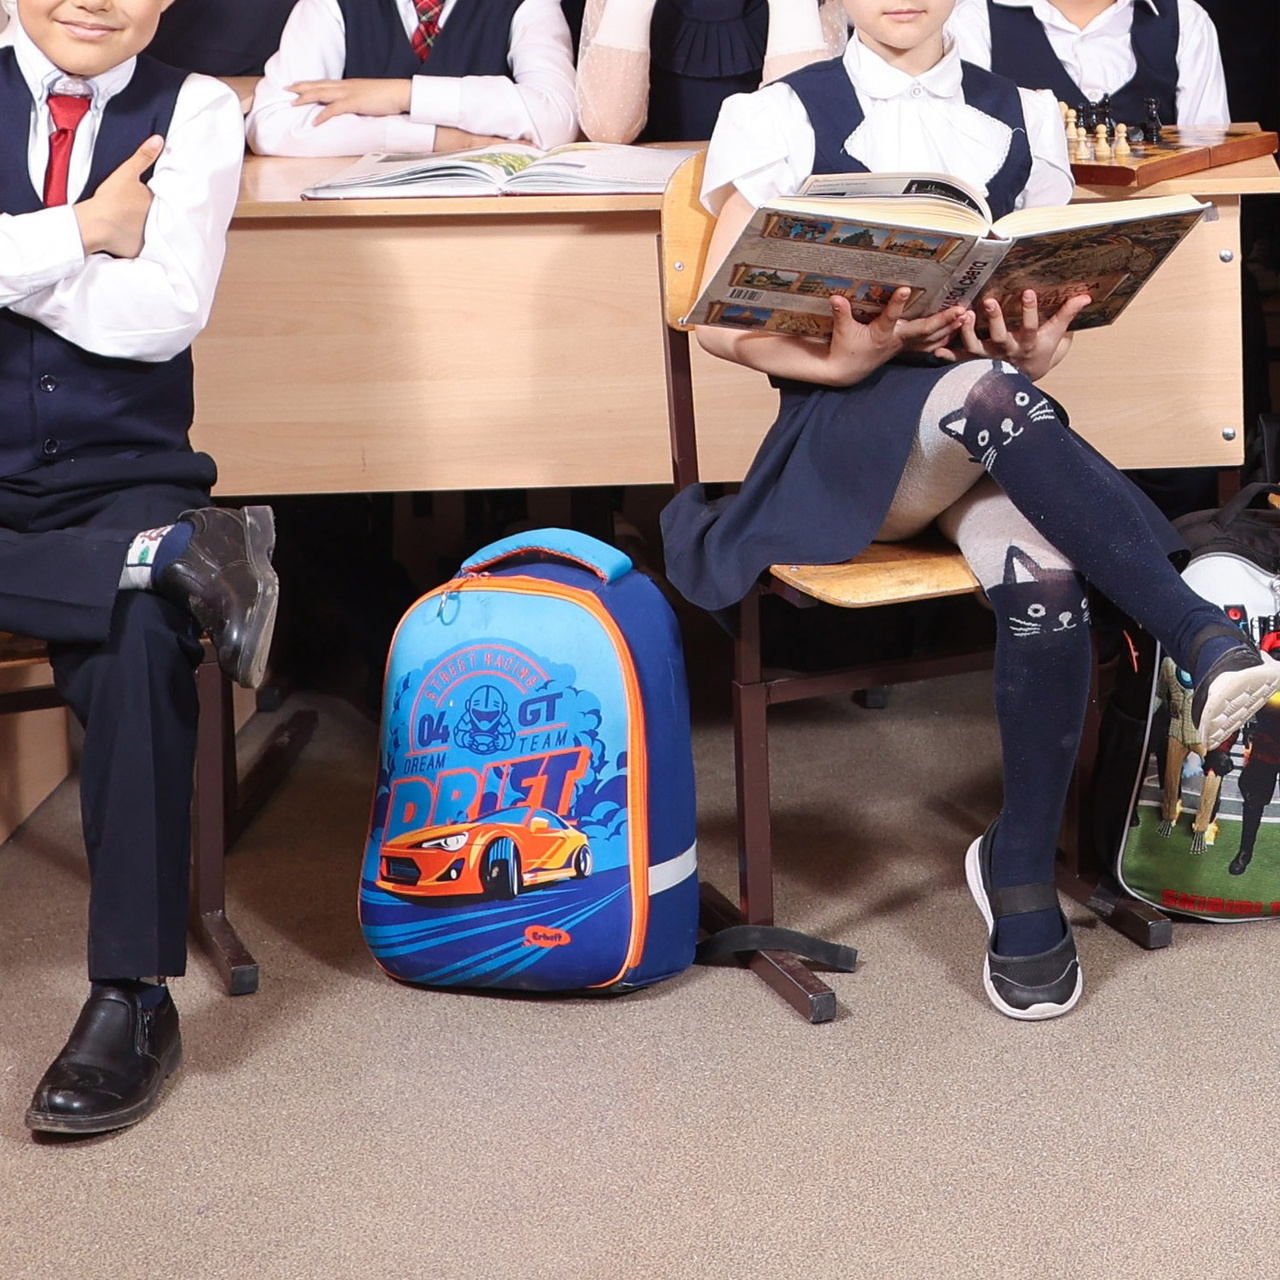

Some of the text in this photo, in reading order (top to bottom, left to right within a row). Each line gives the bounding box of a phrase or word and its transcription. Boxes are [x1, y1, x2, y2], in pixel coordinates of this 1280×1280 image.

[426, 652, 540, 702] STREET RACING
[518, 692, 563, 726] GT
[418, 710, 450, 747] 04
[520, 730, 568, 753] TEAM
[403, 753, 447, 775] DREAM
[384, 746, 591, 838] DRIFT
[1161, 889, 1263, 915] SKIBIDI
